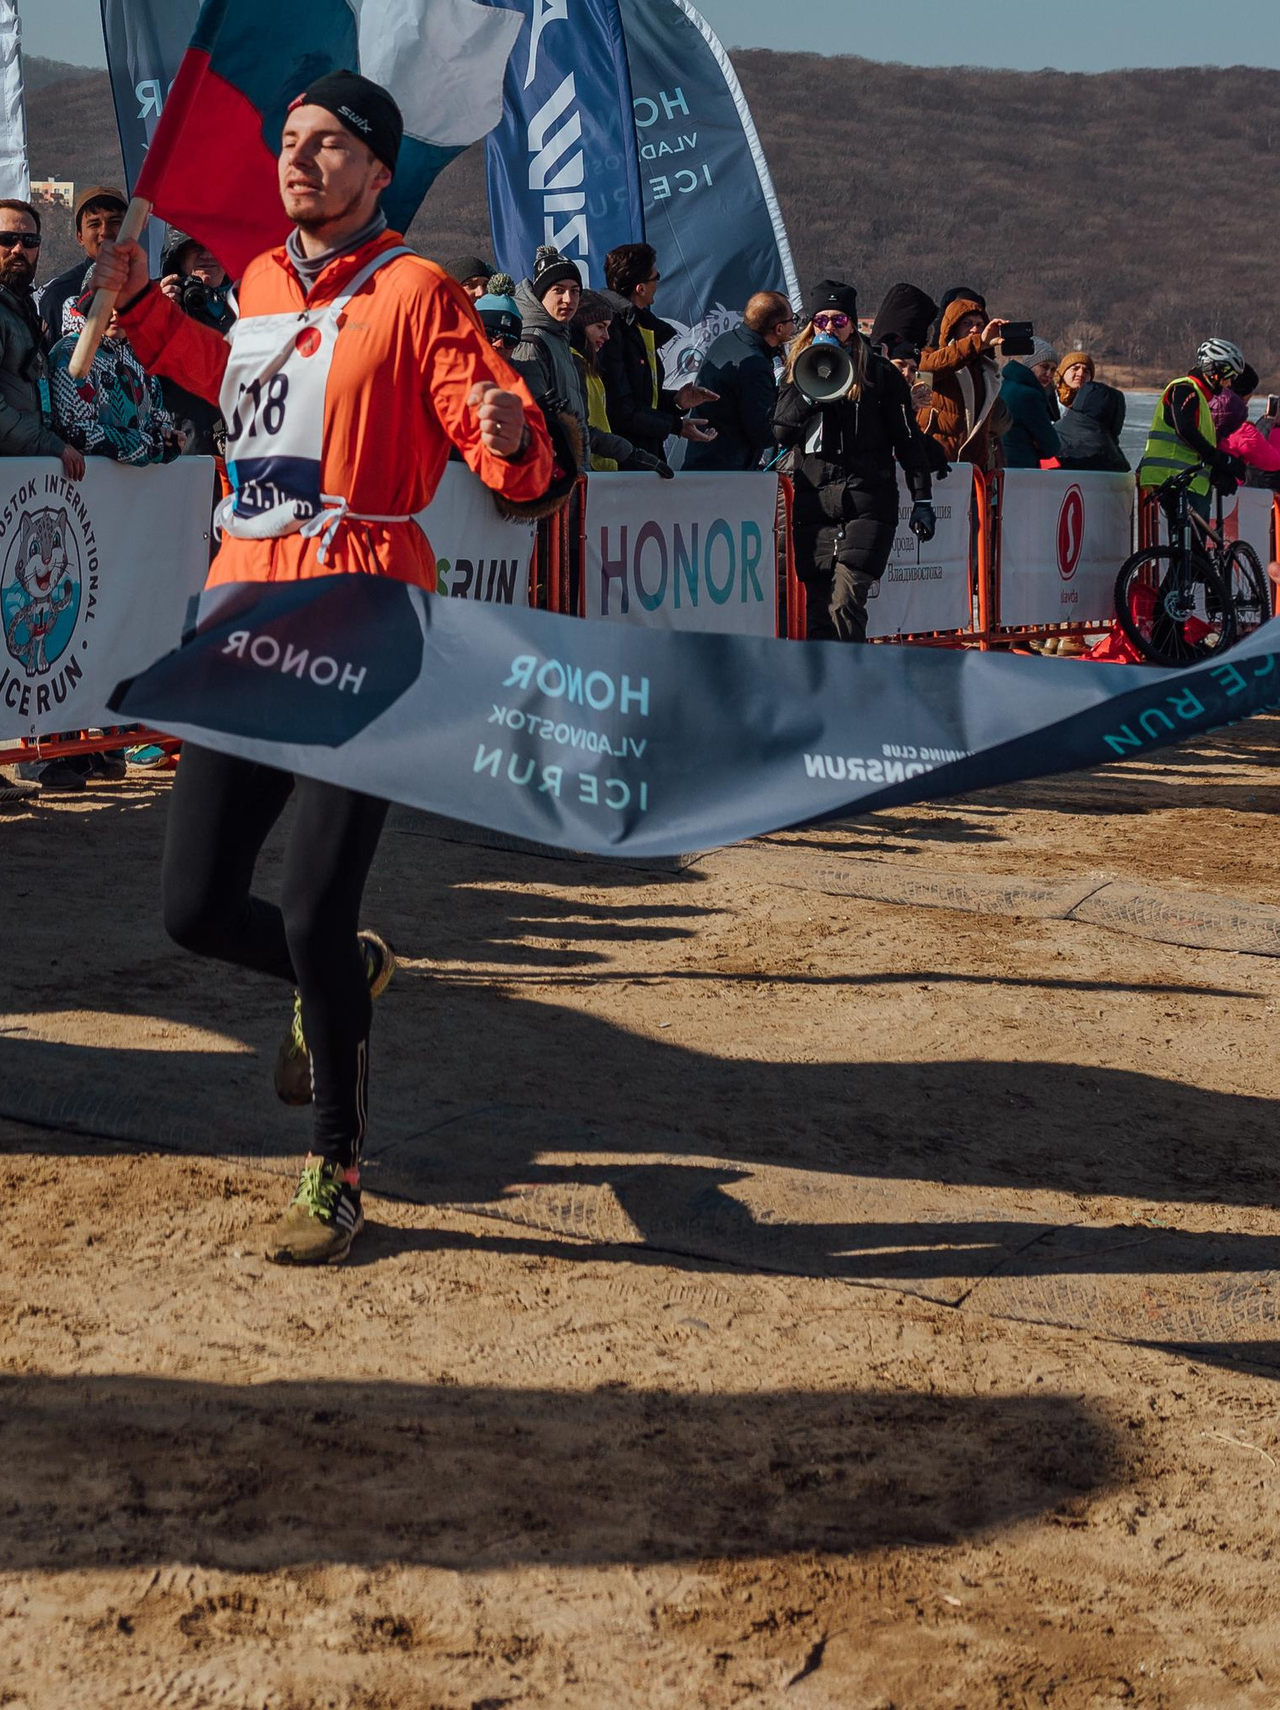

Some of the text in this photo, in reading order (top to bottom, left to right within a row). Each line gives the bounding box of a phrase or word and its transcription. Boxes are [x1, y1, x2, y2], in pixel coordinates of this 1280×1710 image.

[45, 474, 99, 623] INTERNATIONAL
[600, 518, 764, 616] HONOR
[888, 563, 943, 583] Владивостока
[892, 537, 915, 557] орода
[1102, 687, 1206, 755] RUN
